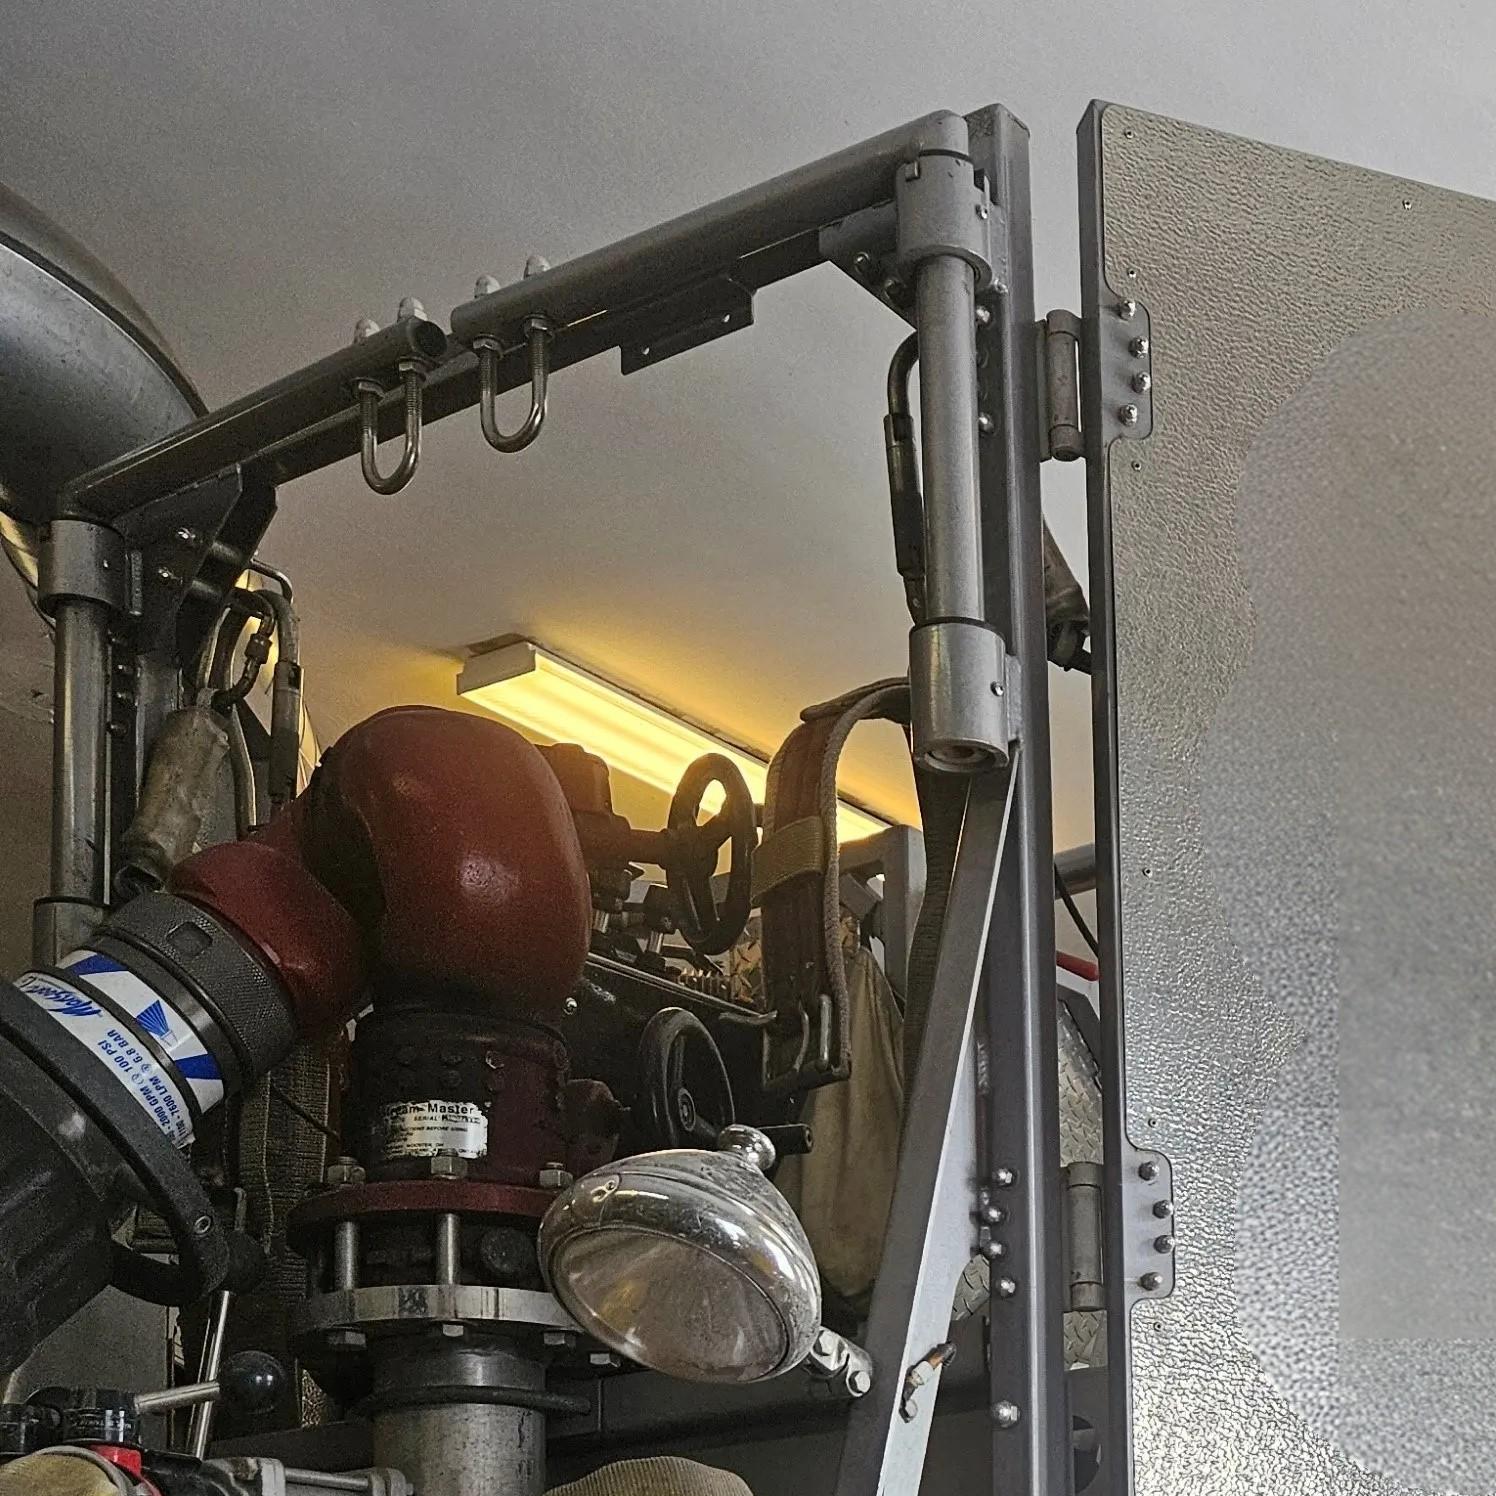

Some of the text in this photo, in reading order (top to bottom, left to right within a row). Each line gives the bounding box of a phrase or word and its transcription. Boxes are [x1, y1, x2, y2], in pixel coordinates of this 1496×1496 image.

[97, 1039, 118, 1056] PSI
[107, 1028, 129, 1049] BAR
[114, 1055, 133, 1073] 100
[125, 1047, 143, 1063] 6.8
[149, 1075, 168, 1095] LPM
[140, 1085, 159, 1107] GPM
[163, 1094, 180, 1116] 7600
[153, 1106, 170, 1127] 2000
[427, 1103, 475, 1115] Master
